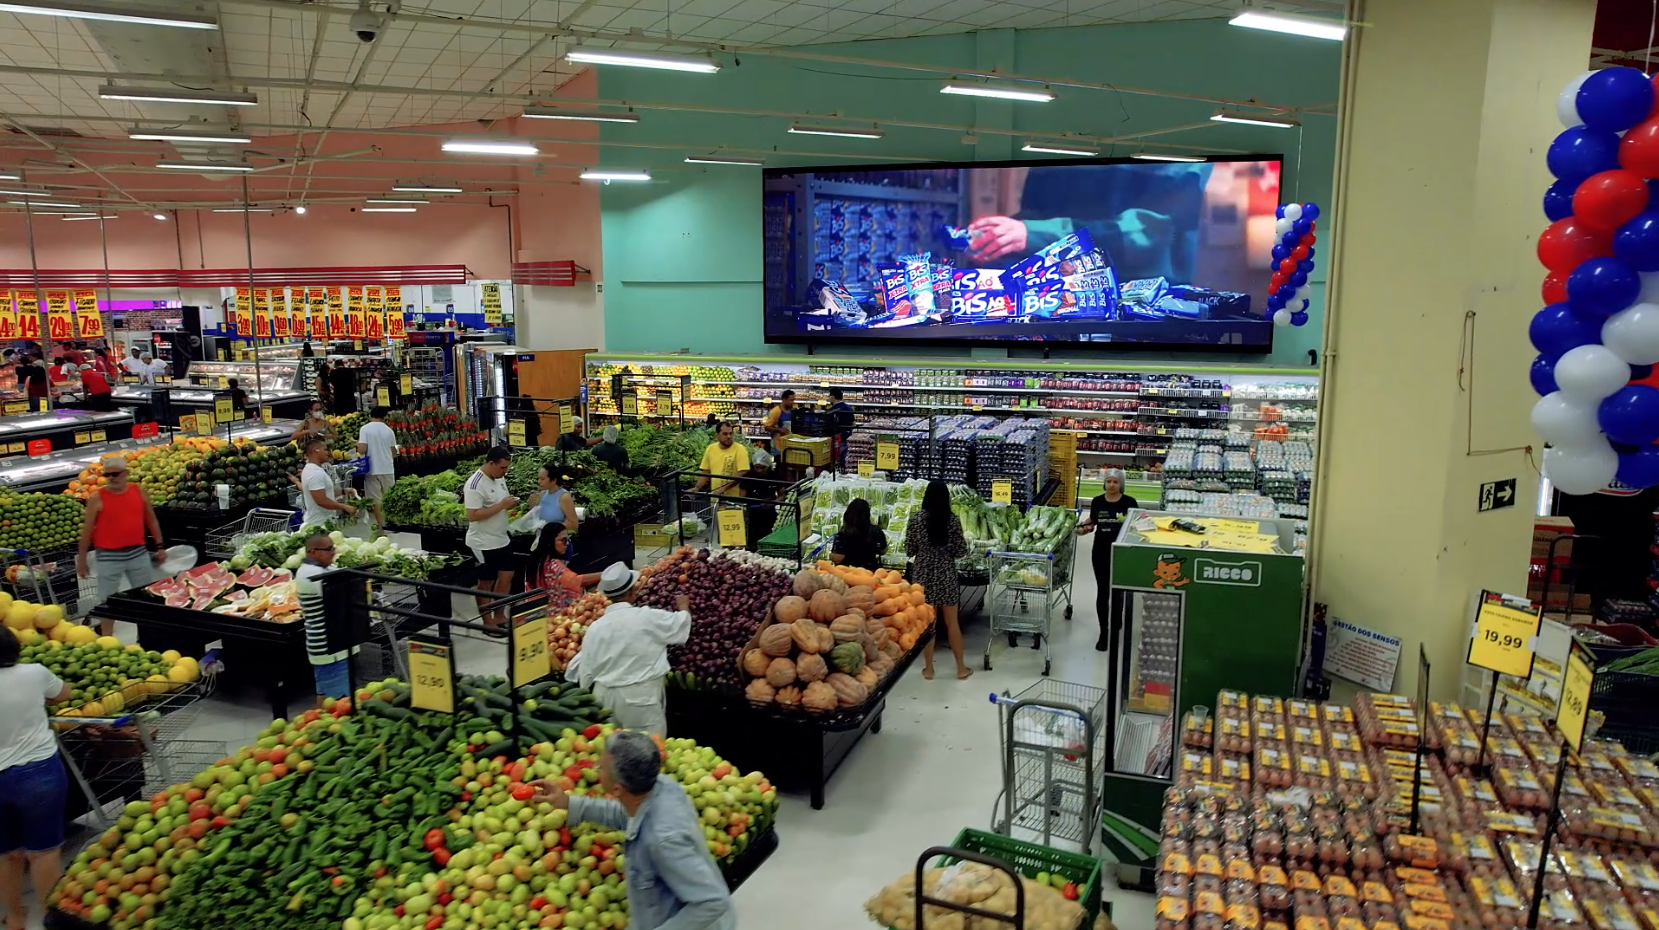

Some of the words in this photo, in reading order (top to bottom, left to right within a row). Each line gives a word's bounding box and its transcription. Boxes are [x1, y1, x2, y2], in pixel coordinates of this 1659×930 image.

[911, 277, 930, 290] XTRA
[933, 281, 951, 291] XTRA
[888, 285, 908, 300] XTRA
[880, 452, 896, 460] 7,99
[723, 523, 741, 532] 12,99
[1203, 566, 1253, 581] RICCO
[1333, 619, 1357, 633] GESTÃO
[1357, 628, 1372, 638] DOS
[1372, 633, 1400, 647] SENSOS
[1485, 629, 1523, 649] 19,99
[416, 674, 445, 688] 12,90
